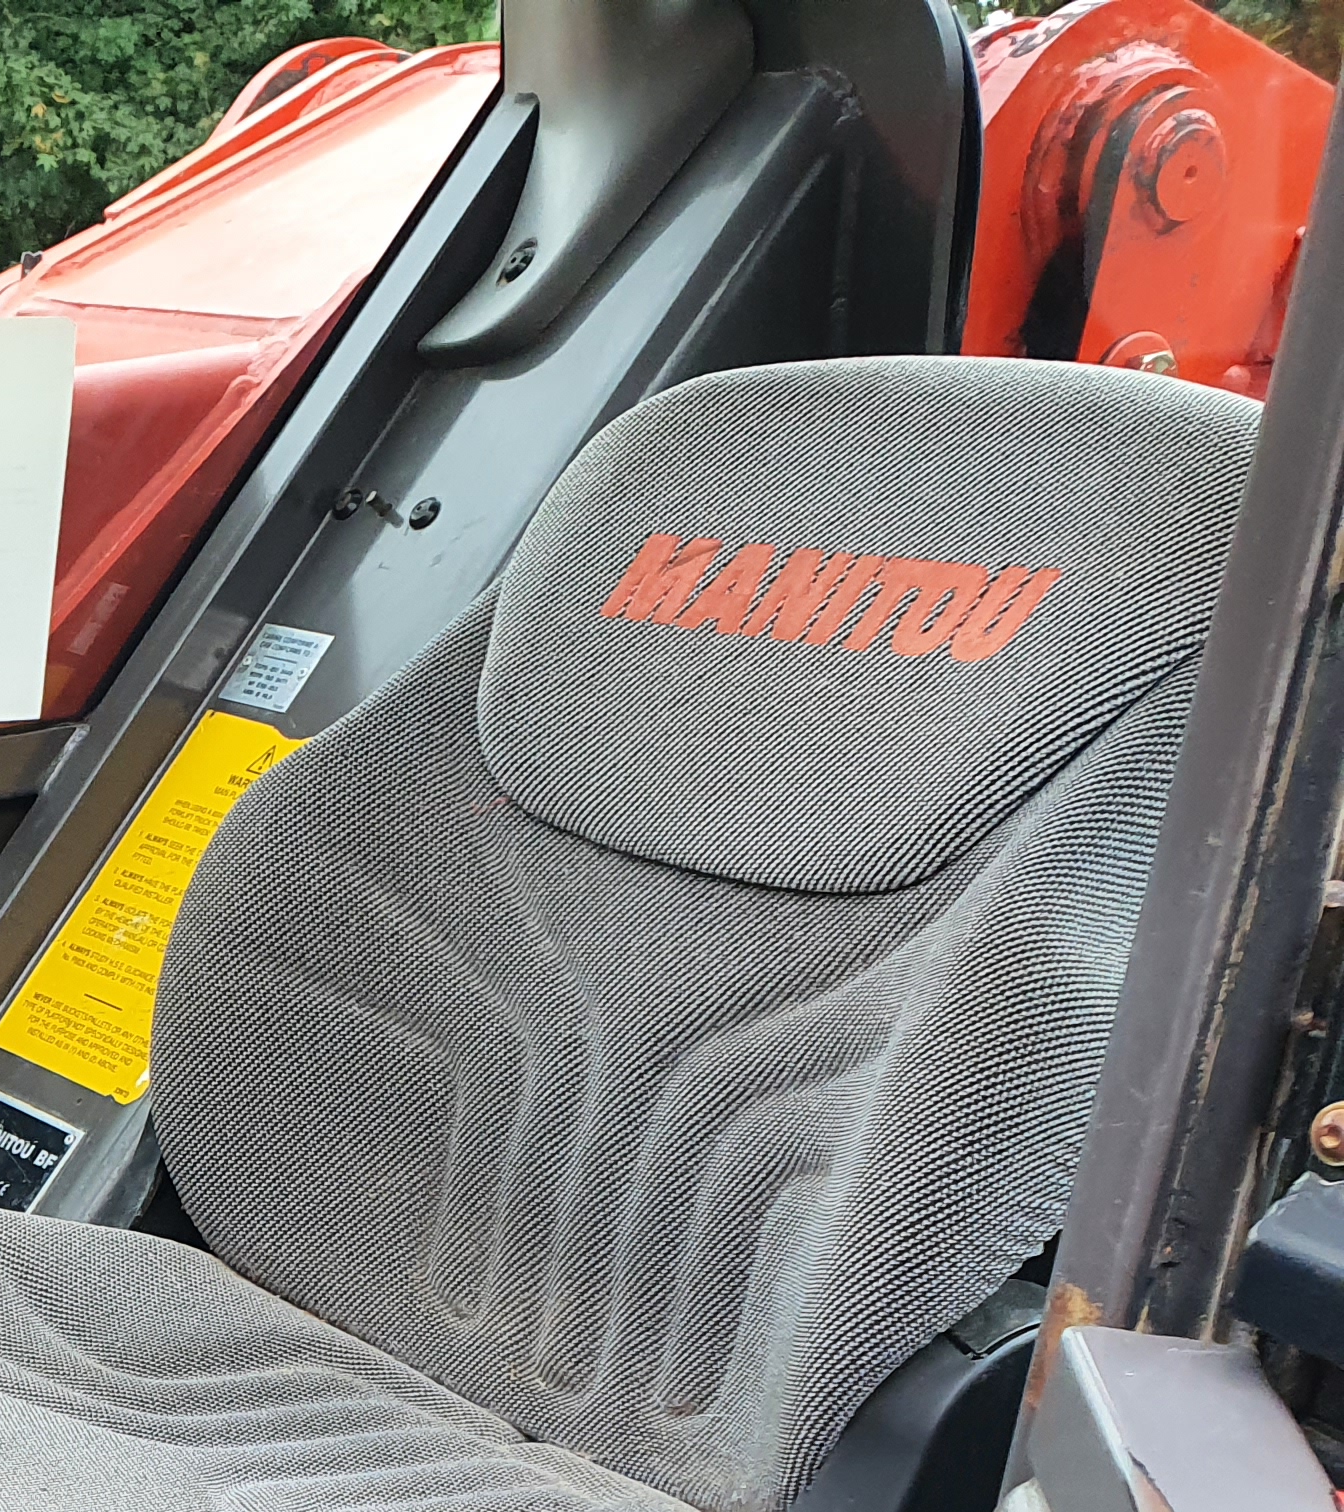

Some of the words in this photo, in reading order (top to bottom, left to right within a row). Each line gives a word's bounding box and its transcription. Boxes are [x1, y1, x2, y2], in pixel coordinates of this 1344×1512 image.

[601, 533, 1062, 662] MANITOU
[227, 774, 252, 790] WAR
[33, 1148, 58, 1170] BF
